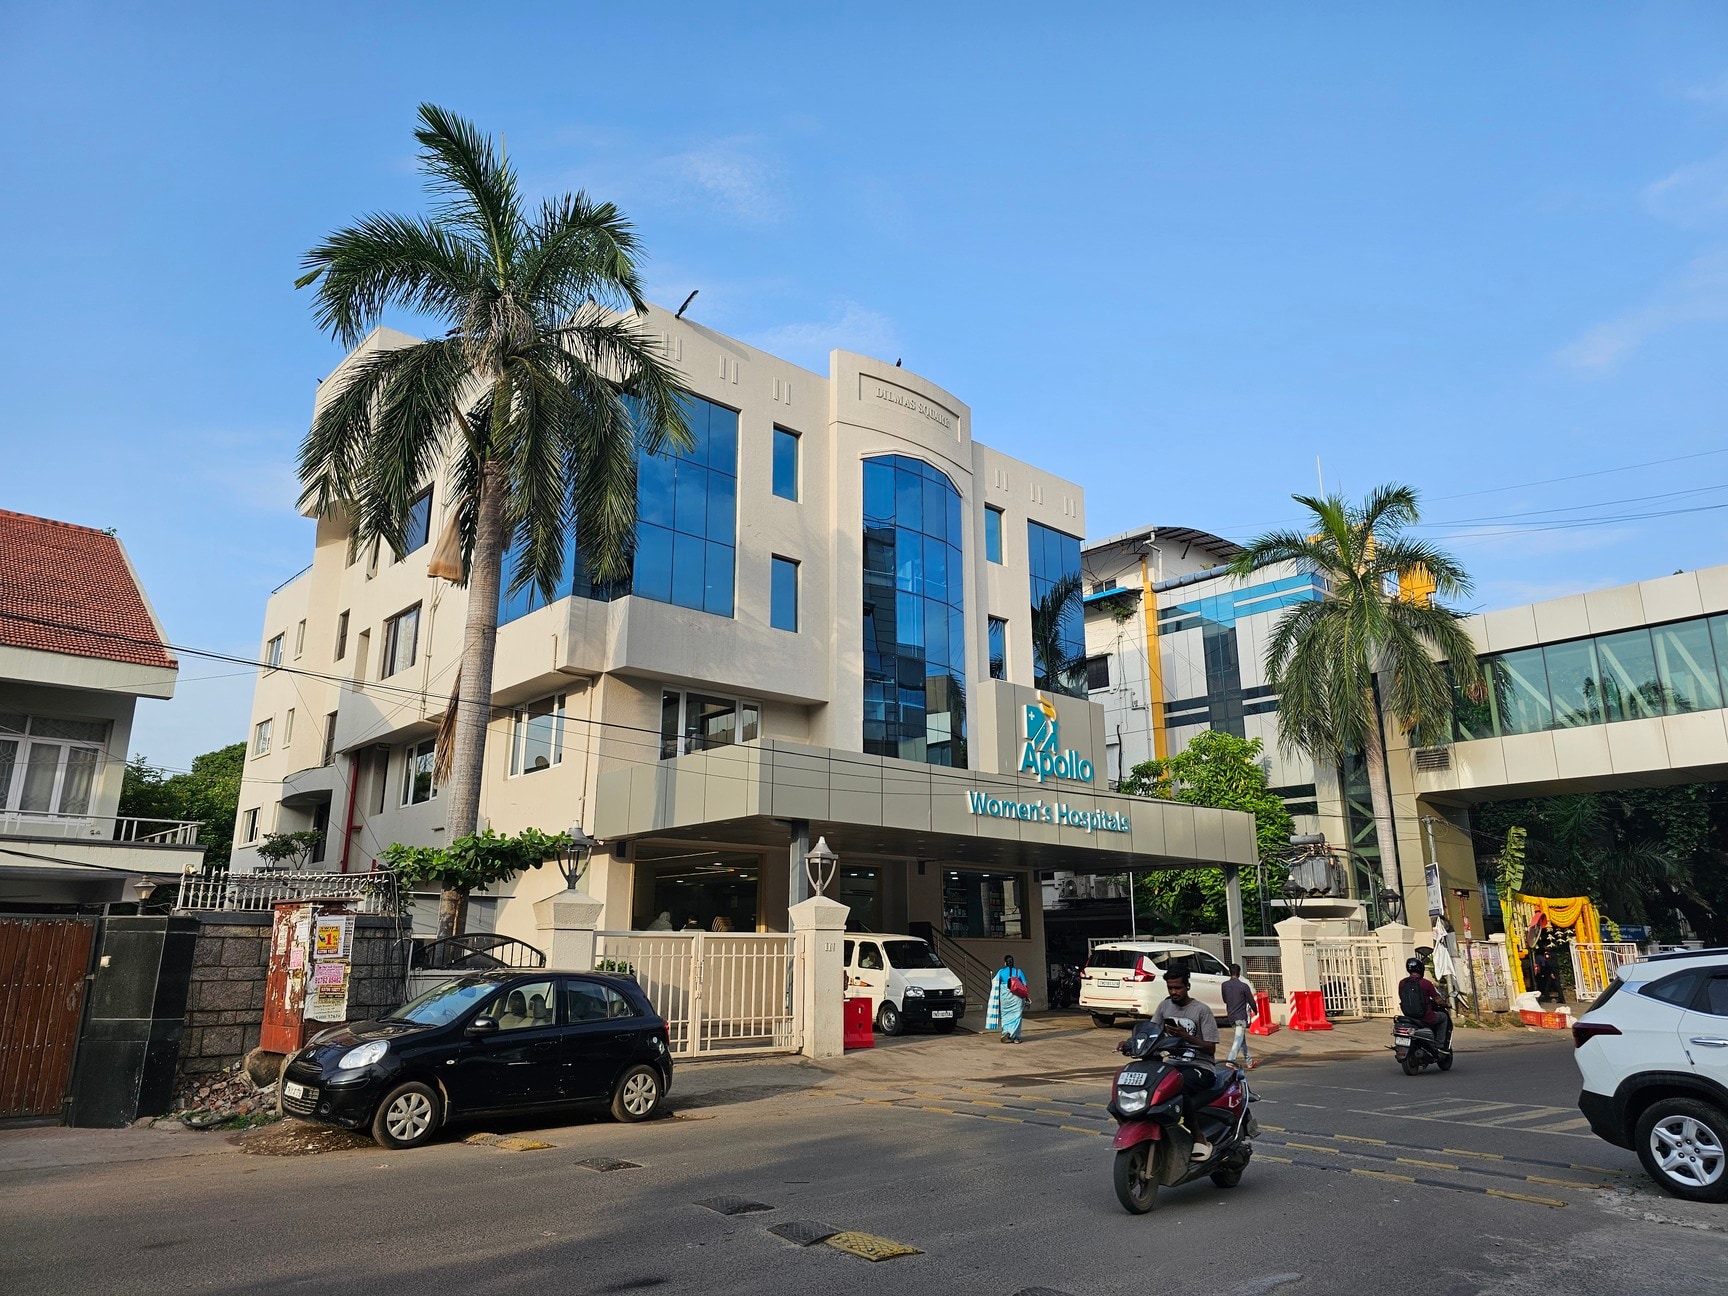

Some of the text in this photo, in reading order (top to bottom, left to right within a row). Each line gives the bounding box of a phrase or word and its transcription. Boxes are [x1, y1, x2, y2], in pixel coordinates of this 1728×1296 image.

[876, 387, 950, 429] DILMAS SQUARE
[1019, 741, 1094, 783] Apollo
[967, 790, 1131, 833] Women's Hospitals
[824, 942, 836, 952] IN
